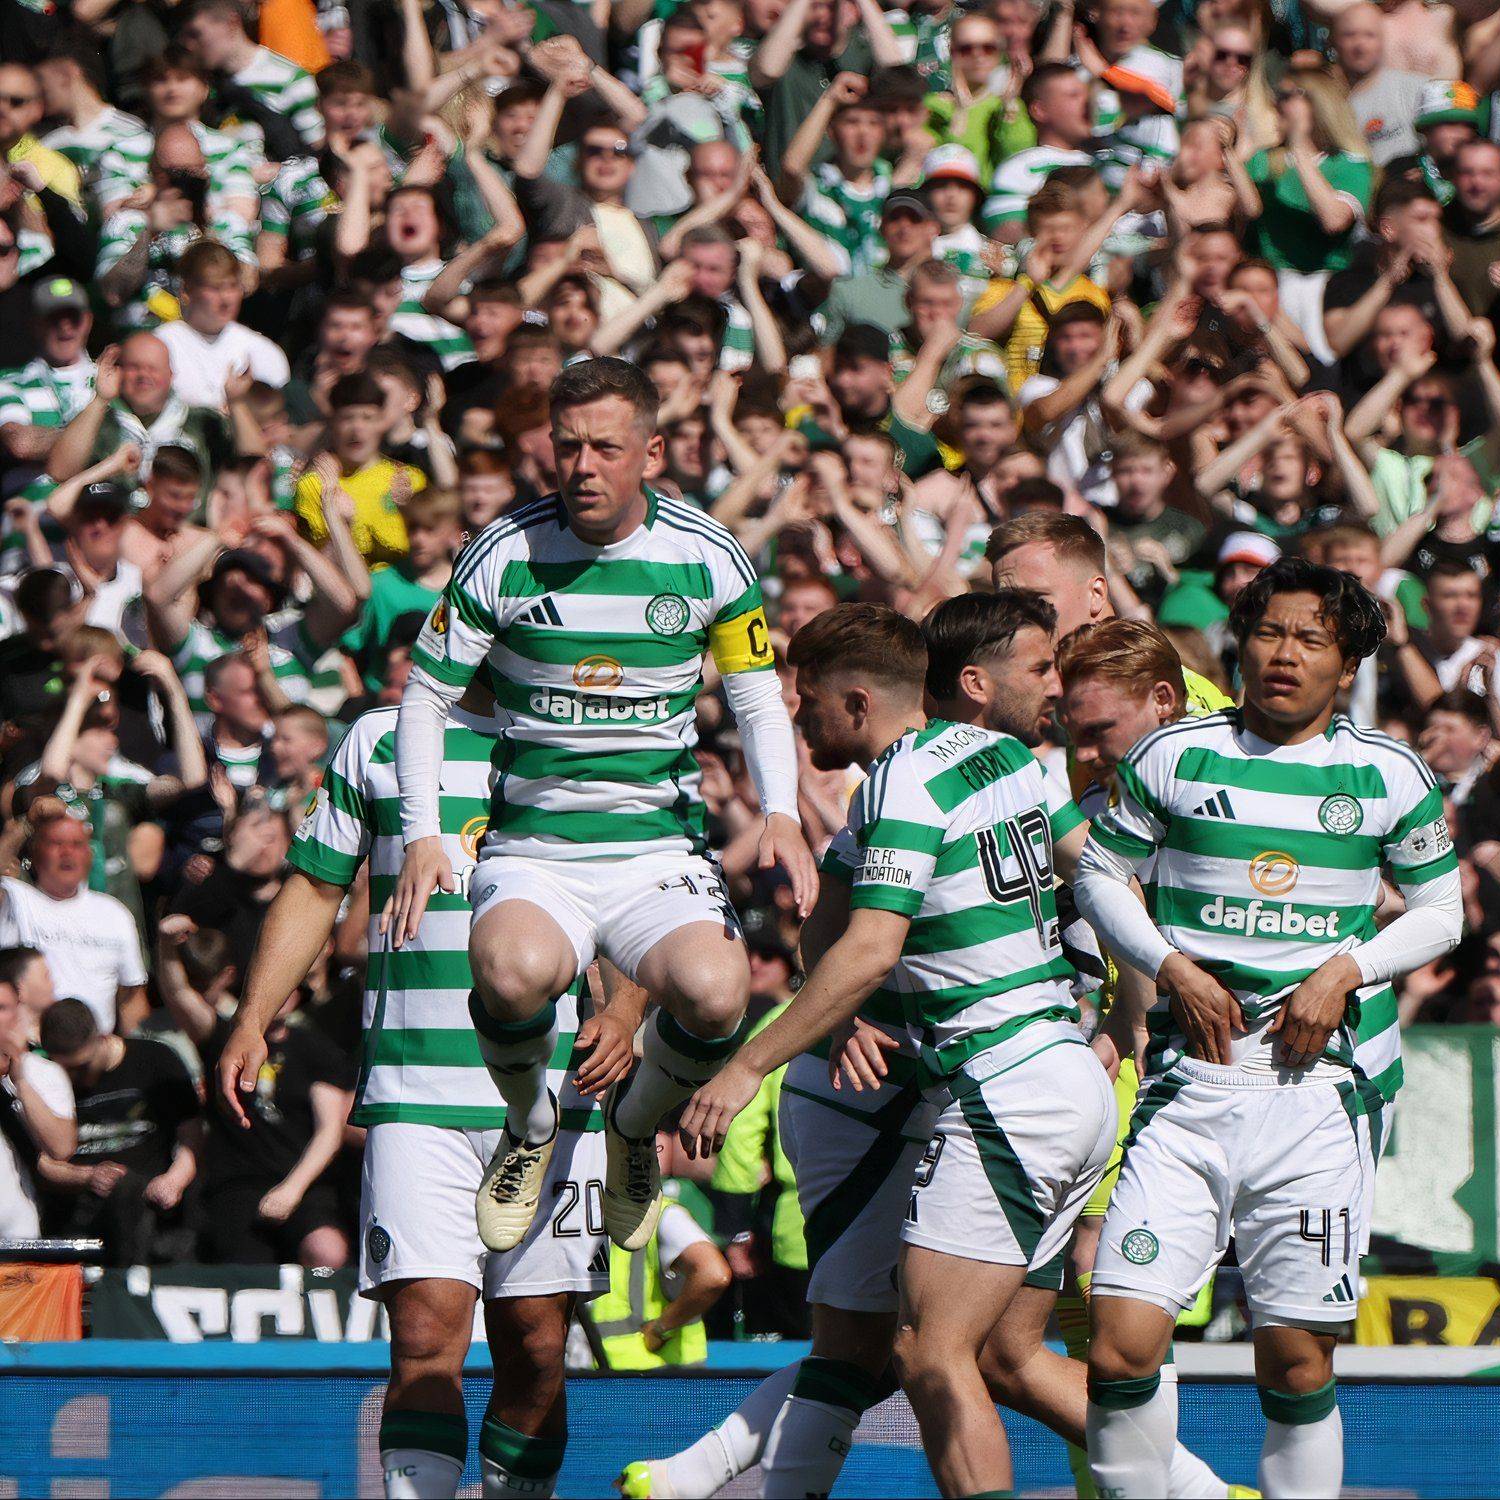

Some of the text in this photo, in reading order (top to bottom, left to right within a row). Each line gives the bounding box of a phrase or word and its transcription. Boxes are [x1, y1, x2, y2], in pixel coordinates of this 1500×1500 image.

[747, 619, 768, 659] C
[529, 686, 671, 725] dafabet
[881, 849, 896, 865] FC
[973, 805, 1061, 951] 49
[1200, 896, 1340, 938] dafabet
[552, 1180, 606, 1238] 20
[1300, 1207, 1351, 1268] 41
